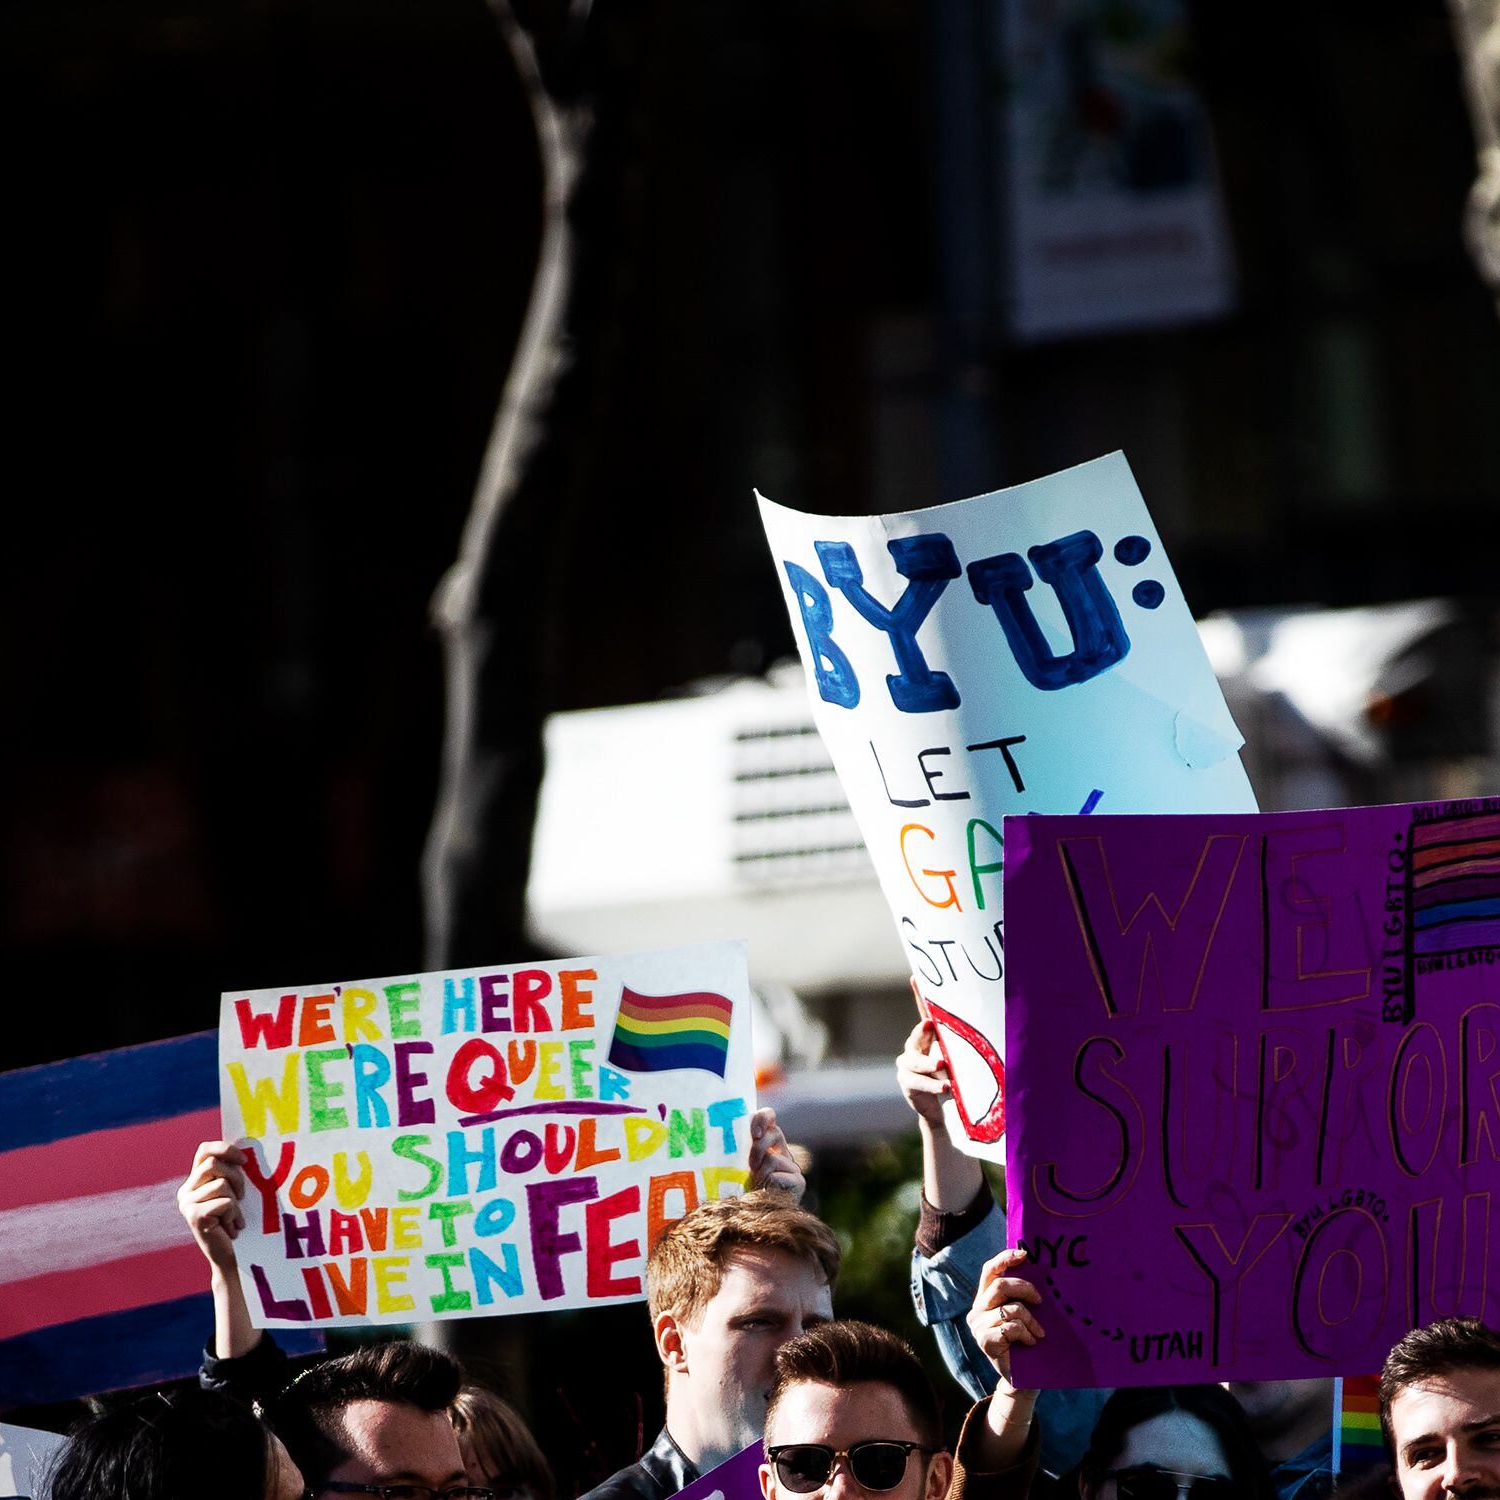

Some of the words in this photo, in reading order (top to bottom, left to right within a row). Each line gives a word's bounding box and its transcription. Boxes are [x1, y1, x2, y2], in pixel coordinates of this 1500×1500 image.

[783, 530, 1165, 713] BYU:
[870, 735, 1027, 808] LET
[1057, 823, 1371, 1018] WE
[234, 981, 422, 1050] WE'RE
[442, 968, 598, 1036] HERE
[226, 1040, 436, 1138] WE'RE
[446, 1038, 632, 1114] QUEER
[241, 1141, 372, 1234] YOU
[282, 1206, 422, 1259] HAVE
[429, 1199, 515, 1247] TO
[250, 1256, 415, 1322] LIVE
[425, 1242, 525, 1314] IN
[1130, 1328, 1203, 1363] UTAH
